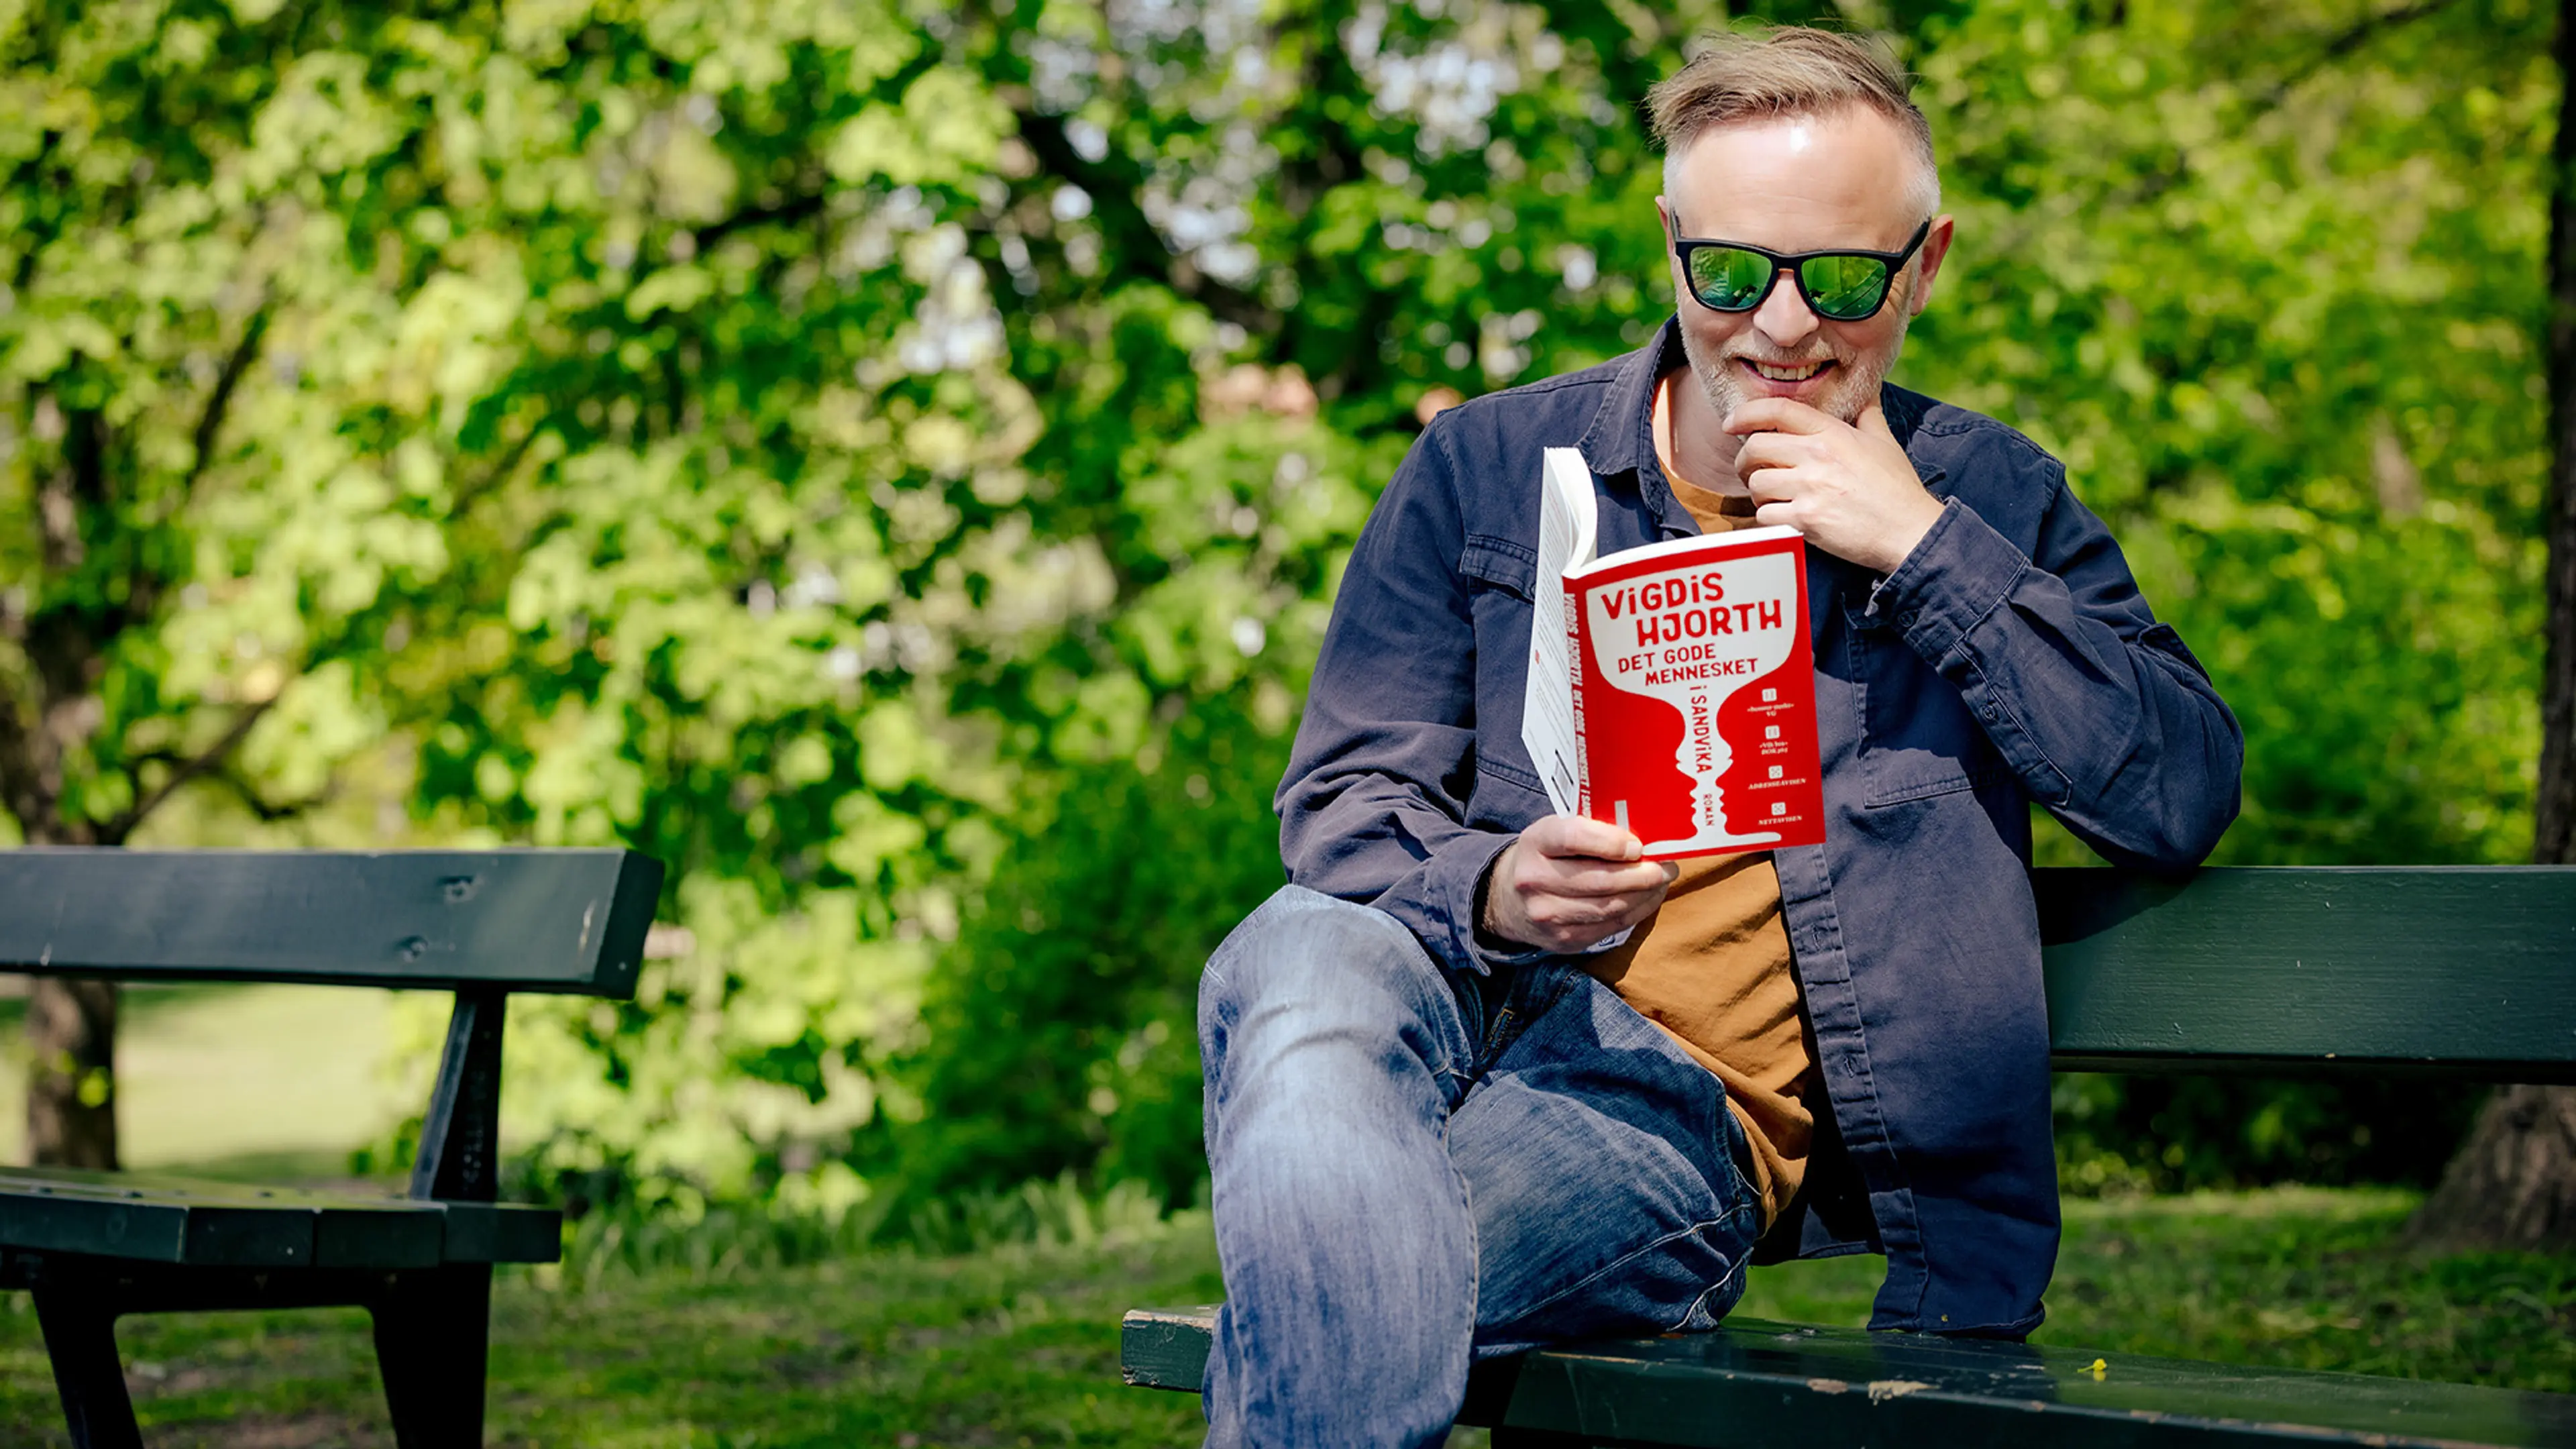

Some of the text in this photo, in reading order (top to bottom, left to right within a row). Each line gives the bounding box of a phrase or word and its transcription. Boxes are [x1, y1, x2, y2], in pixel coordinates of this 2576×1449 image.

[1636, 599, 1782, 647] HJORTH
[1618, 643, 1716, 674] DET GODE
[1645, 658, 1758, 686] MENNESKET
[1703, 794, 1715, 826] ROMAN
